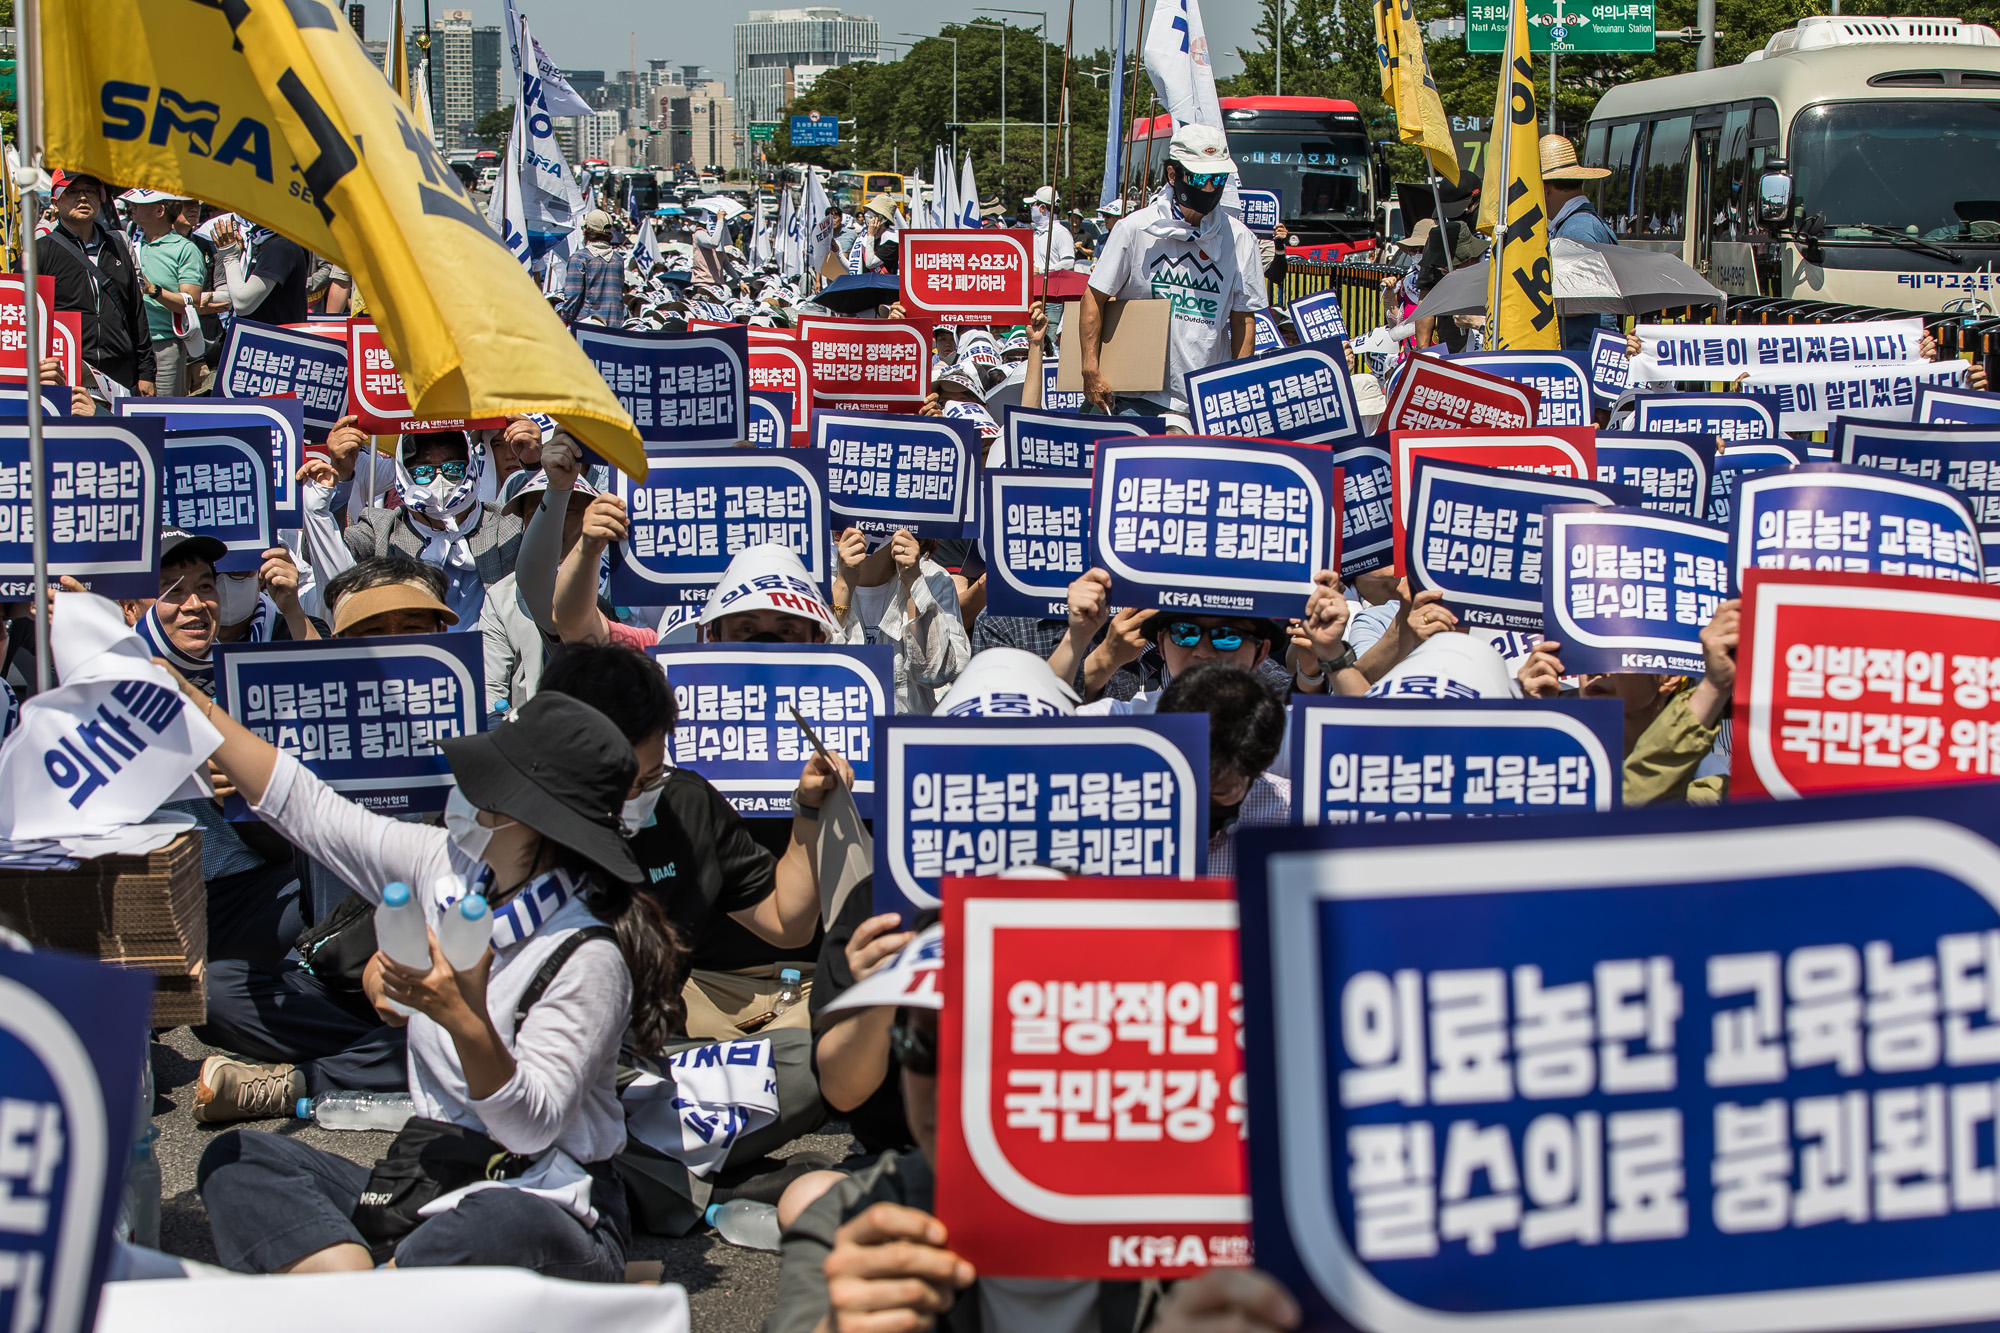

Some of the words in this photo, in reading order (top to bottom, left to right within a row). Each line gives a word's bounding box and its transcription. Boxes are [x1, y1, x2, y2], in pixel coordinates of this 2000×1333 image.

[1471, 6, 1529, 20] 국회의
[1592, 5, 1651, 19] 여의나루역
[1592, 24, 1625, 33] Yeouinaru
[1628, 24, 1651, 33] Station
[1550, 42, 1574, 50] 150m
[1552, 29, 1564, 37] 46
[102, 80, 273, 183] SMA
[1247, 213, 1275, 225] 붕괴된다
[1248, 200, 1275, 213] 교육농단
[915, 253, 965, 271] 비과학적
[967, 253, 1019, 271] 수요조사
[1717, 266, 1745, 287] 1544-8963
[927, 274, 953, 291] 즉각
[955, 274, 1006, 292] 폐기하라
[1184, 315, 1215, 325] Outdoors
[1303, 304, 1339, 328] 의료농단
[236, 346, 295, 377] 의료농단
[296, 358, 348, 388] 교육농단
[812, 342, 863, 361] 일방적인
[866, 343, 917, 361] 정책추진
[1656, 338, 1748, 367] 의사들이
[1757, 334, 1907, 364] 살리겠습니다!
[659, 362, 731, 394] 교육농단
[813, 363, 863, 381] 국민건강
[865, 364, 917, 382] 위협한다
[660, 395, 734, 426] 붕괴된다
[835, 403, 860, 411] KMA
[1204, 383, 1265, 421] 의료농단
[1269, 367, 1333, 406] 교육농단
[1411, 384, 1471, 419] 일방적인
[400, 421, 430, 430] KMA
[430, 419, 464, 427] 대한의사협회
[1276, 395, 1341, 431] 붕괴된다
[828, 439, 893, 469] 의료농단
[896, 444, 955, 472] 교육농단
[1021, 436, 1079, 468] 의료농단
[51, 461, 141, 499] 교육농단
[174, 461, 252, 495] 교육농단
[828, 468, 891, 498] 필수의료
[895, 472, 954, 501] 붕괴된다
[177, 495, 255, 528] 붕괴된다
[633, 485, 717, 520] 의료농단
[724, 484, 807, 519] 교육농단
[1115, 477, 1210, 516] 의료농단
[1216, 481, 1308, 524] 교육농단
[52, 504, 141, 543] 붕괴된다
[856, 520, 885, 532] KMA
[1007, 504, 1082, 538] 의료농단
[1429, 499, 1518, 544] 의료농단
[634, 523, 719, 557] 필수의료
[1008, 539, 1083, 572] 필수의료
[1114, 517, 1208, 557] 필수의료
[1215, 522, 1309, 564] 붕괴된다
[1756, 509, 1871, 553] 의료농단
[1878, 514, 1978, 572] 교육농단
[1426, 536, 1514, 581] 필수의료
[1570, 543, 1667, 582] 의료농단
[1158, 591, 1202, 608] KMA
[1203, 594, 1254, 607] 대한의사협회
[1571, 583, 1668, 621] 필수의료
[1464, 609, 1505, 626] KMA
[1621, 653, 1668, 669] KMA
[1785, 643, 1945, 706] 일방적인
[247, 681, 348, 720] 의료농단
[356, 676, 457, 717] 교육농단
[674, 684, 767, 721] 의료농단
[774, 685, 868, 721] 교육농단
[674, 726, 769, 763] 필수의료
[1781, 709, 1945, 770] 국민건강
[911, 772, 1039, 823] 의료농단
[1048, 770, 1175, 822] 교육농단
[1326, 753, 1455, 804] 의료농단
[1463, 755, 1590, 806] 교육농단
[911, 828, 1038, 878] 필수의료
[1049, 827, 1175, 877] 붕괴된다
[649, 861, 676, 884] WAAC
[1006, 979, 1219, 1056] 일방적인
[1338, 954, 1684, 1109] 의료농단
[1704, 928, 2000, 1089] 교육농단
[1004, 1068, 1221, 1143] 국민건강
[1346, 1105, 1690, 1262] 필수의료
[1108, 1234, 1209, 1268] KMA
